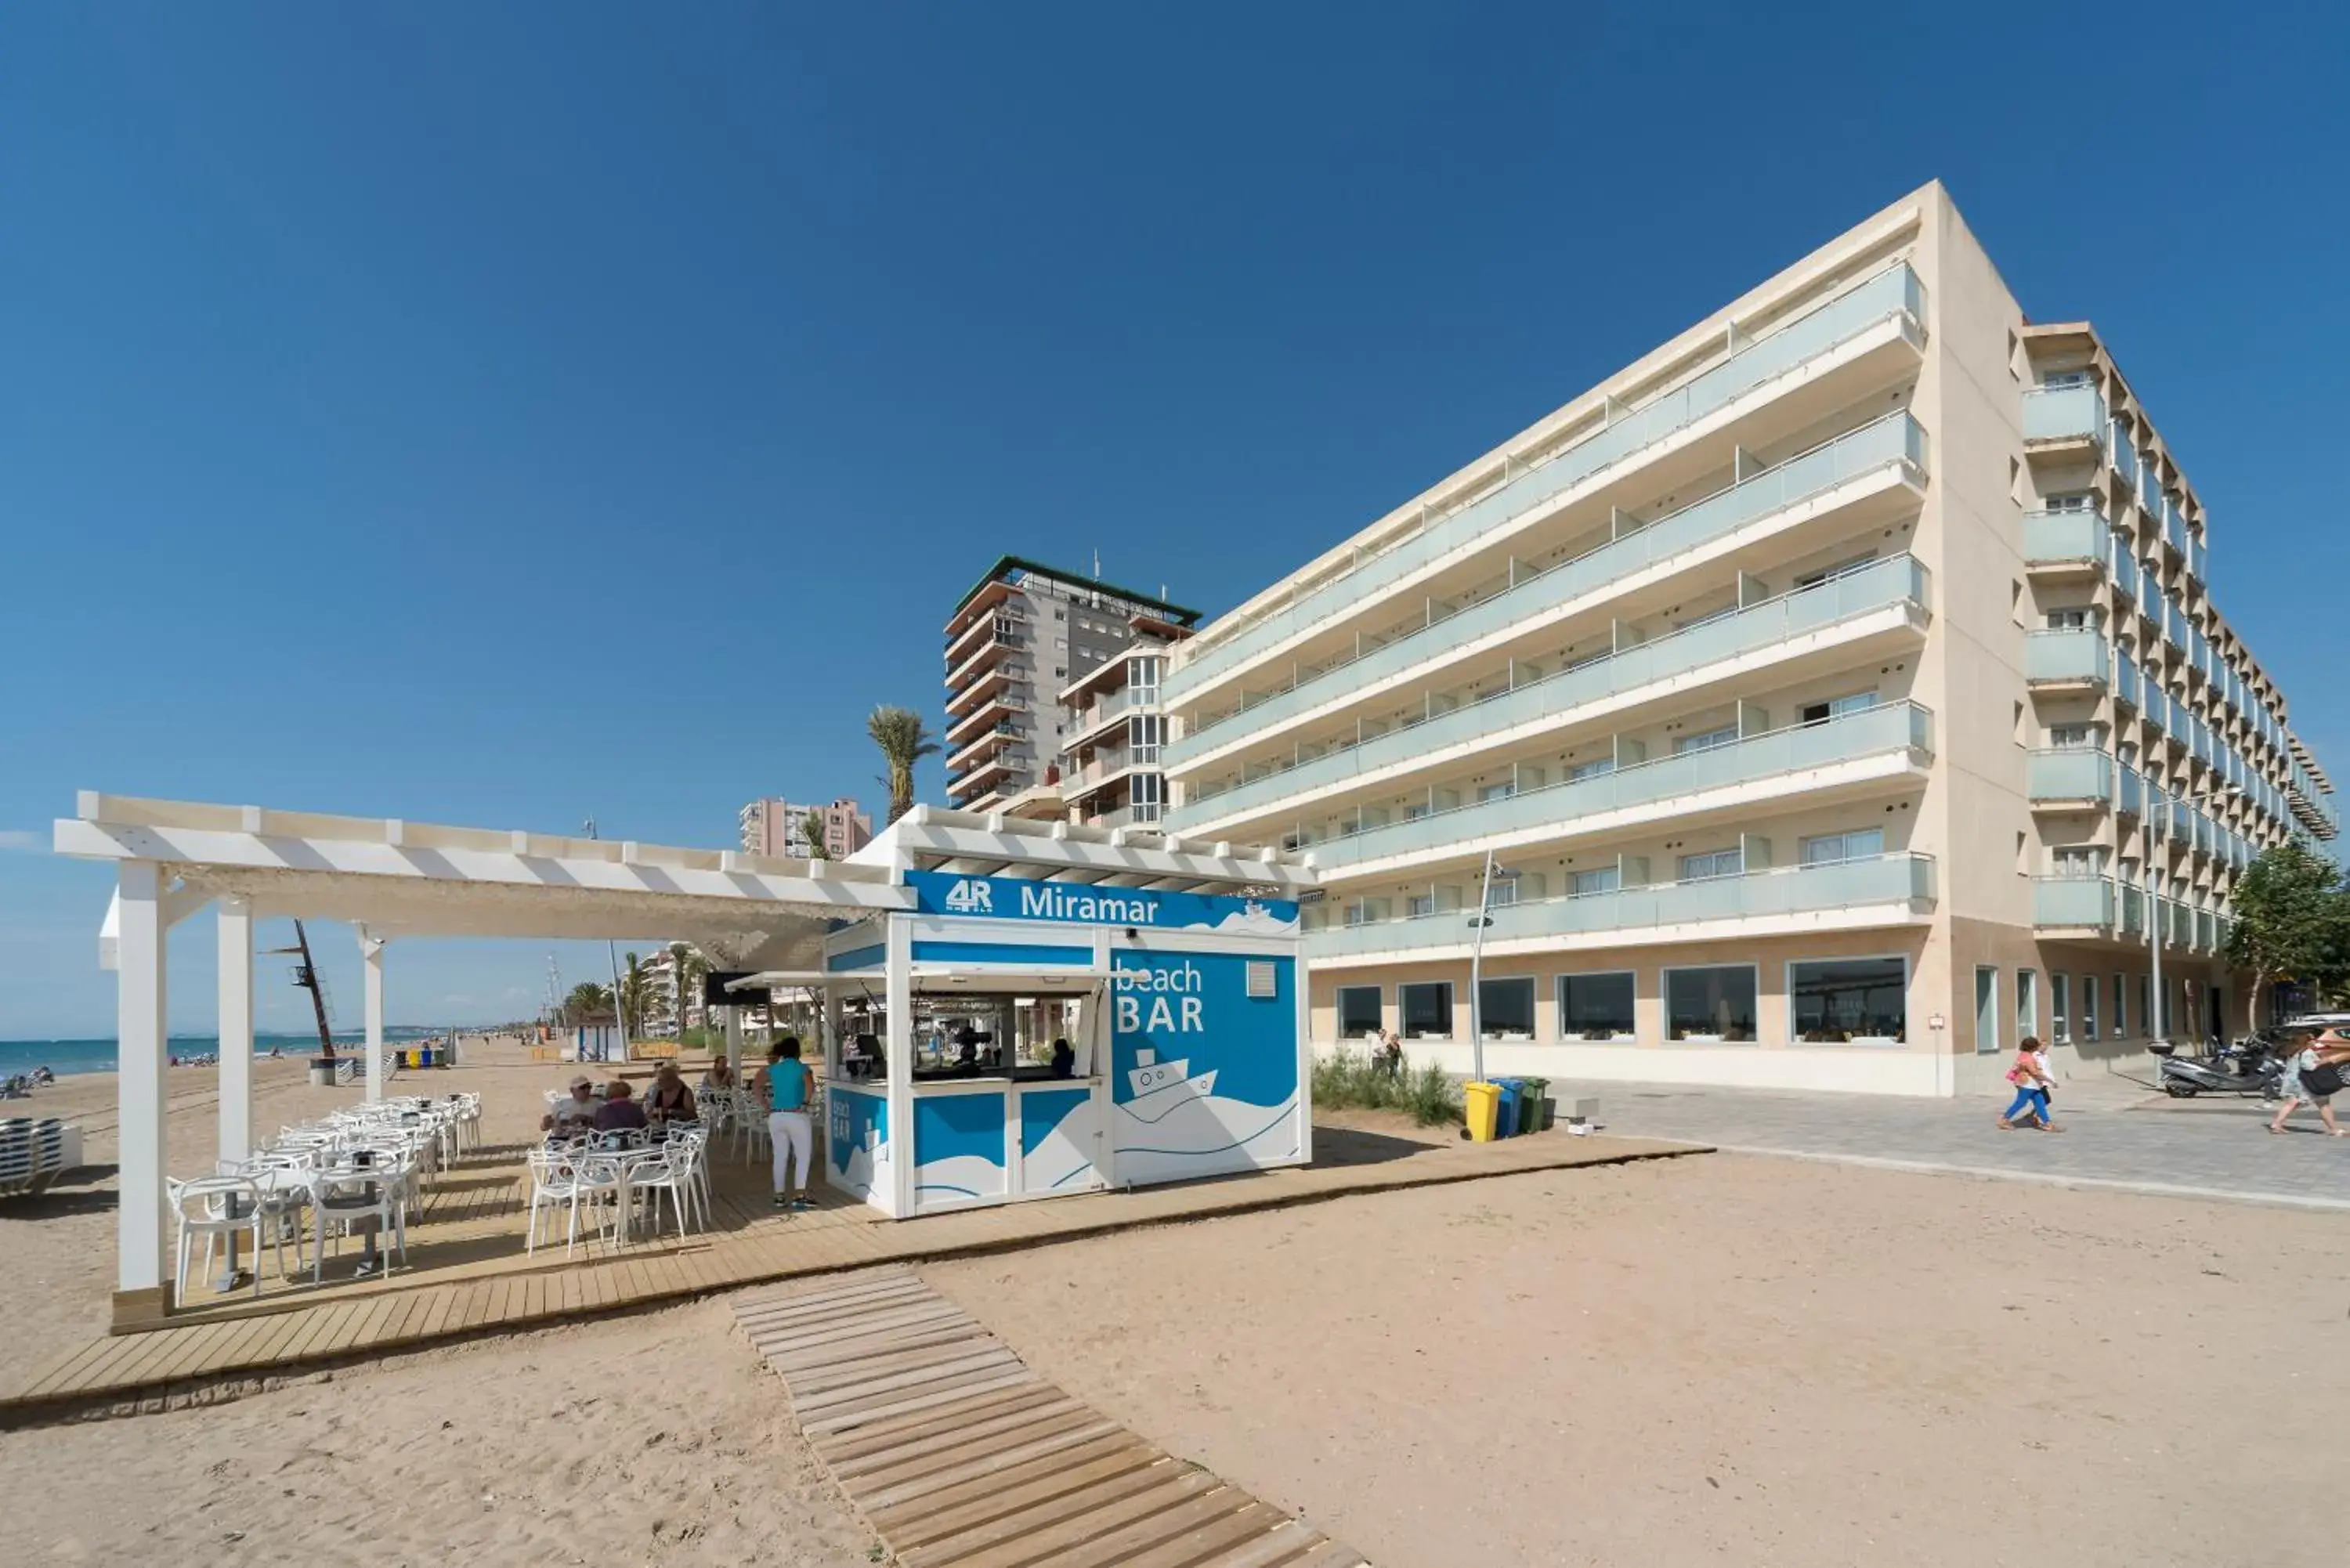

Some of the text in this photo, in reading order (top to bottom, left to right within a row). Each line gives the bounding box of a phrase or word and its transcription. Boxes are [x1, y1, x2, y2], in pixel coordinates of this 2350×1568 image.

[945, 879, 1159, 923] 4R Miramar
[1115, 957, 1202, 992] beach
[1117, 995, 1204, 1033] BAR
